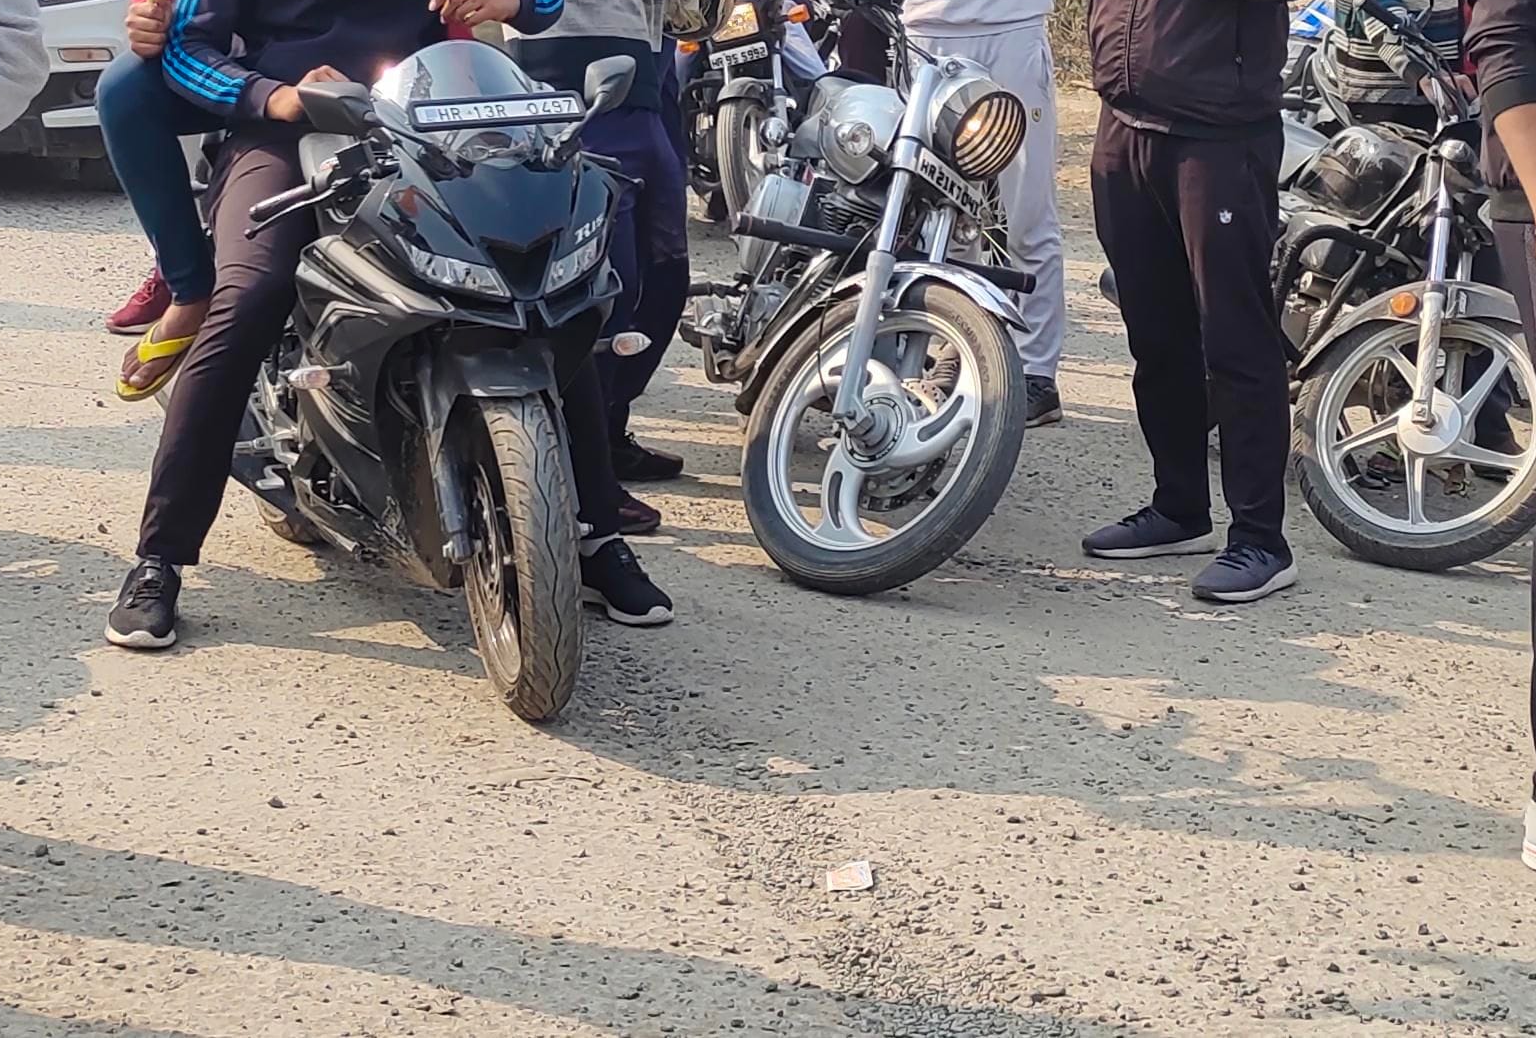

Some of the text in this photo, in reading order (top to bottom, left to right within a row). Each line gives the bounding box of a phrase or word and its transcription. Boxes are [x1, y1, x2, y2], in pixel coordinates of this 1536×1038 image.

[438, 99, 573, 121] HR 13R 0497
[574, 215, 605, 245] R15
